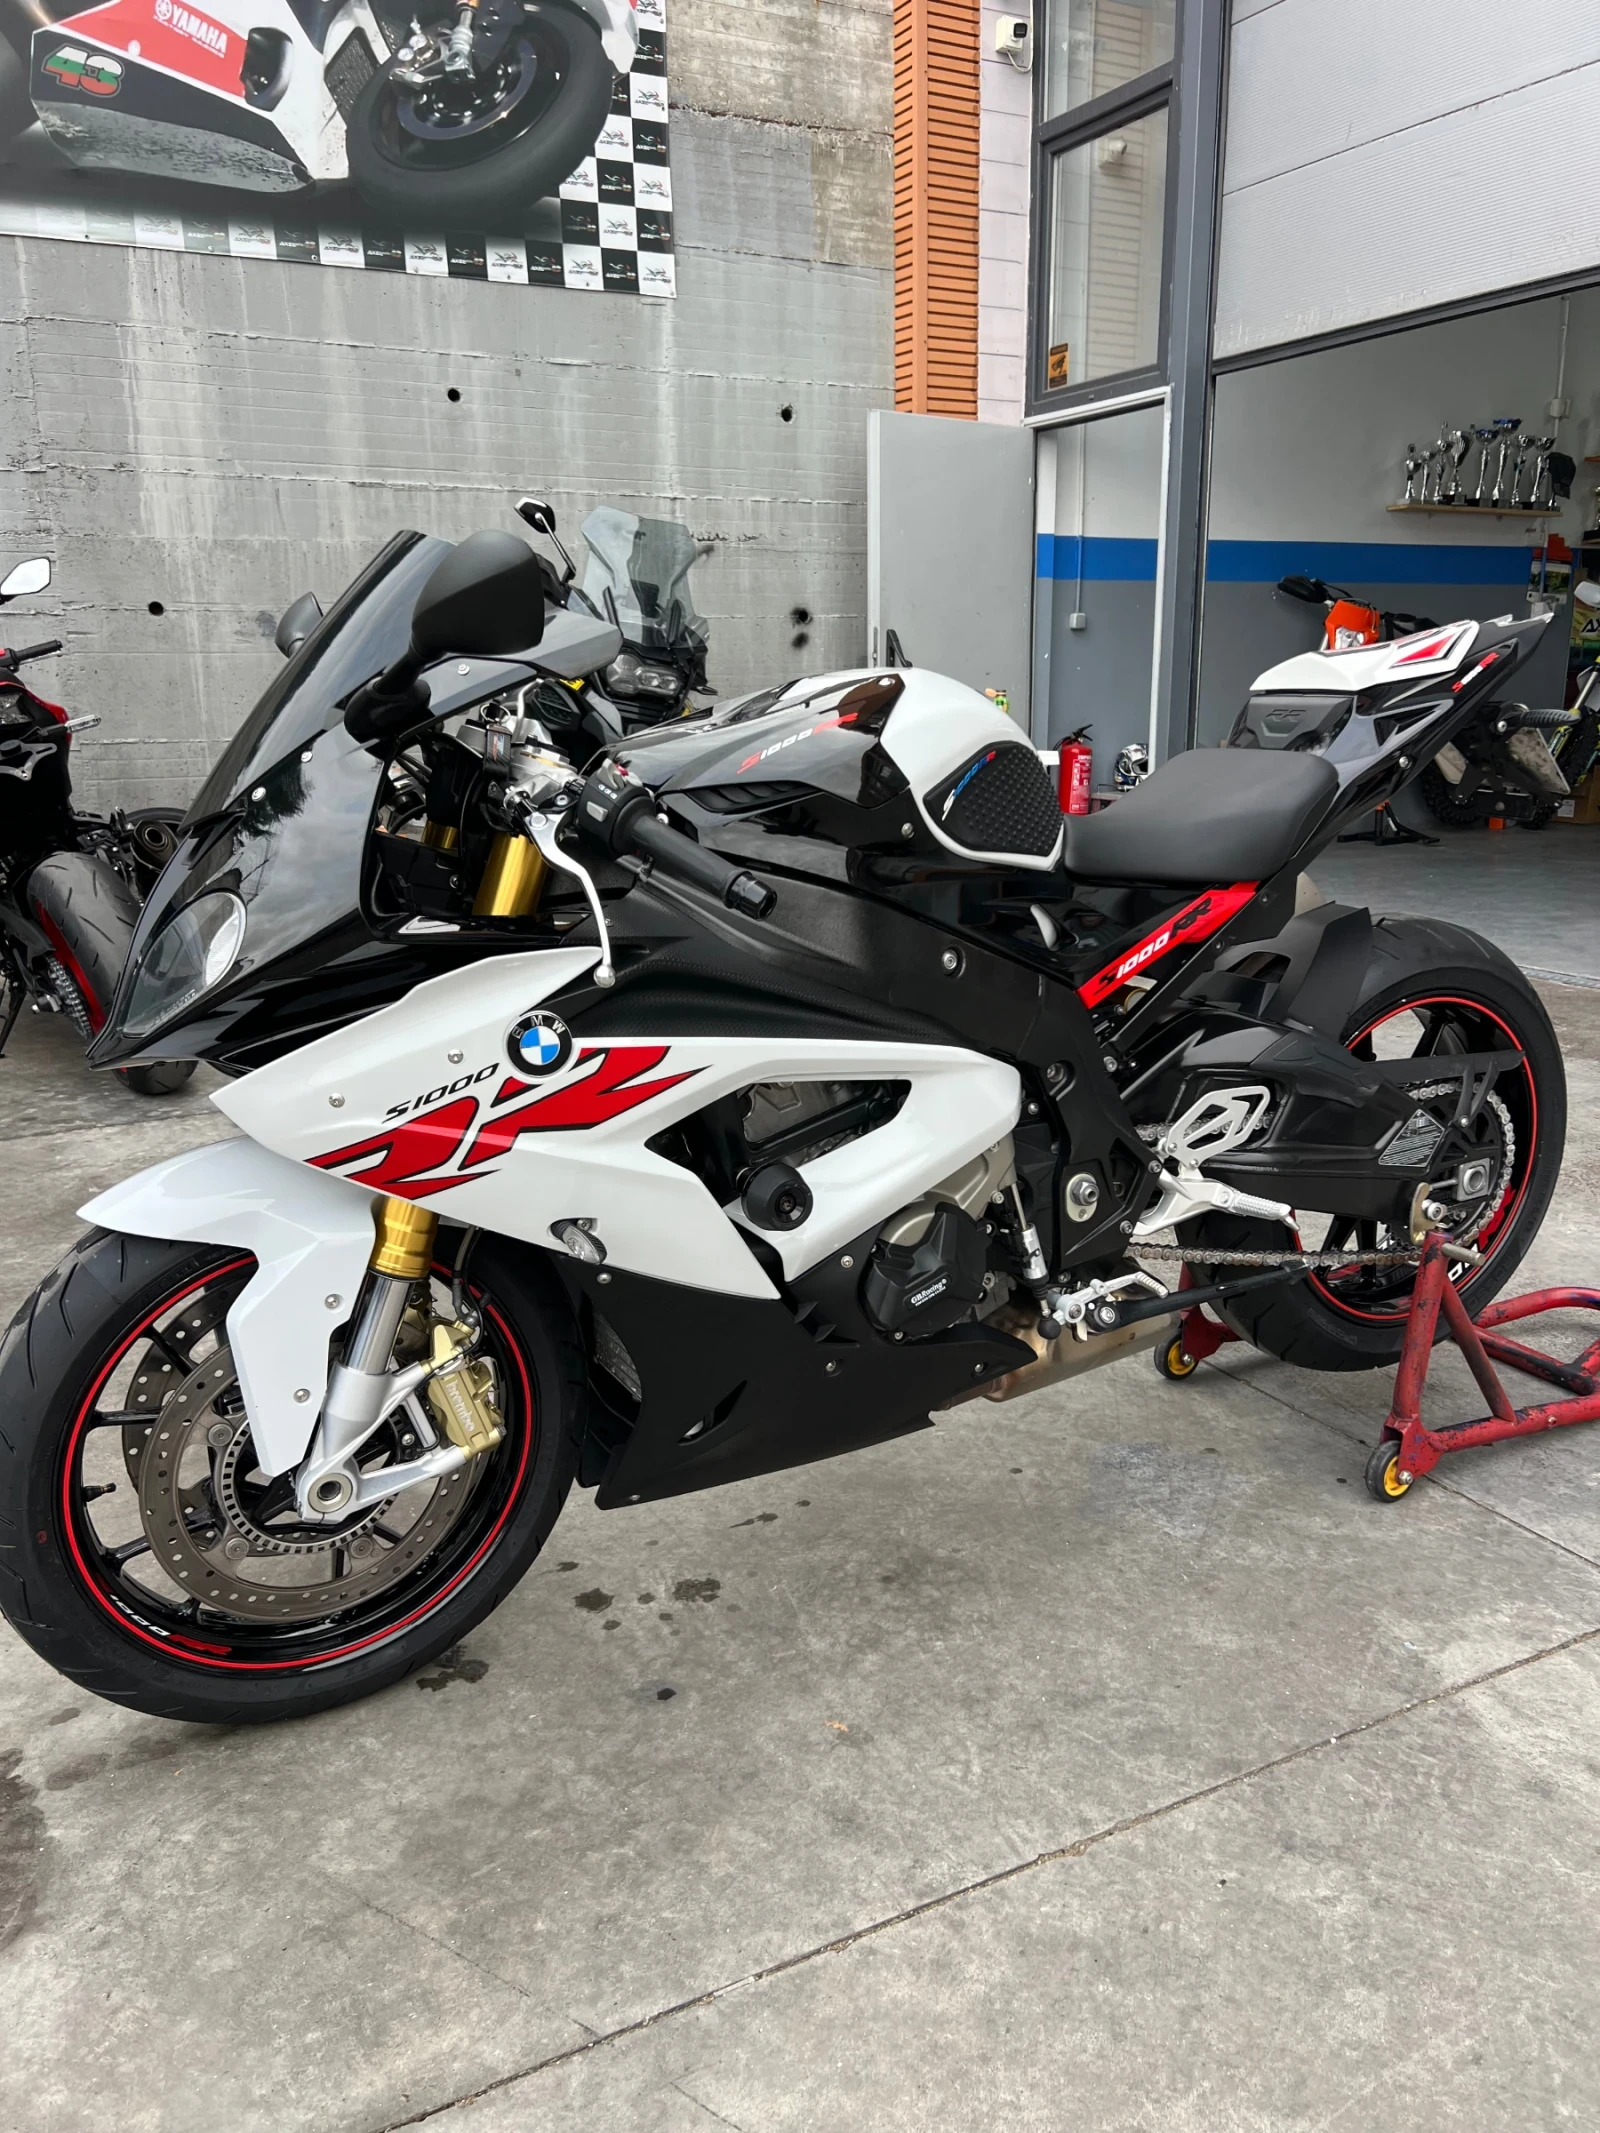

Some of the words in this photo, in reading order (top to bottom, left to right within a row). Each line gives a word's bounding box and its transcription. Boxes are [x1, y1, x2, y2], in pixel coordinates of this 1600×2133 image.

[171, 4, 229, 54] YAMAHA
[42, 44, 125, 97] 43
[1093, 896, 1213, 996] S1000RR
[510, 1014, 567, 1040] BMW
[381, 1062, 500, 1125] S1000
[444, 1379, 476, 1433] brembo
